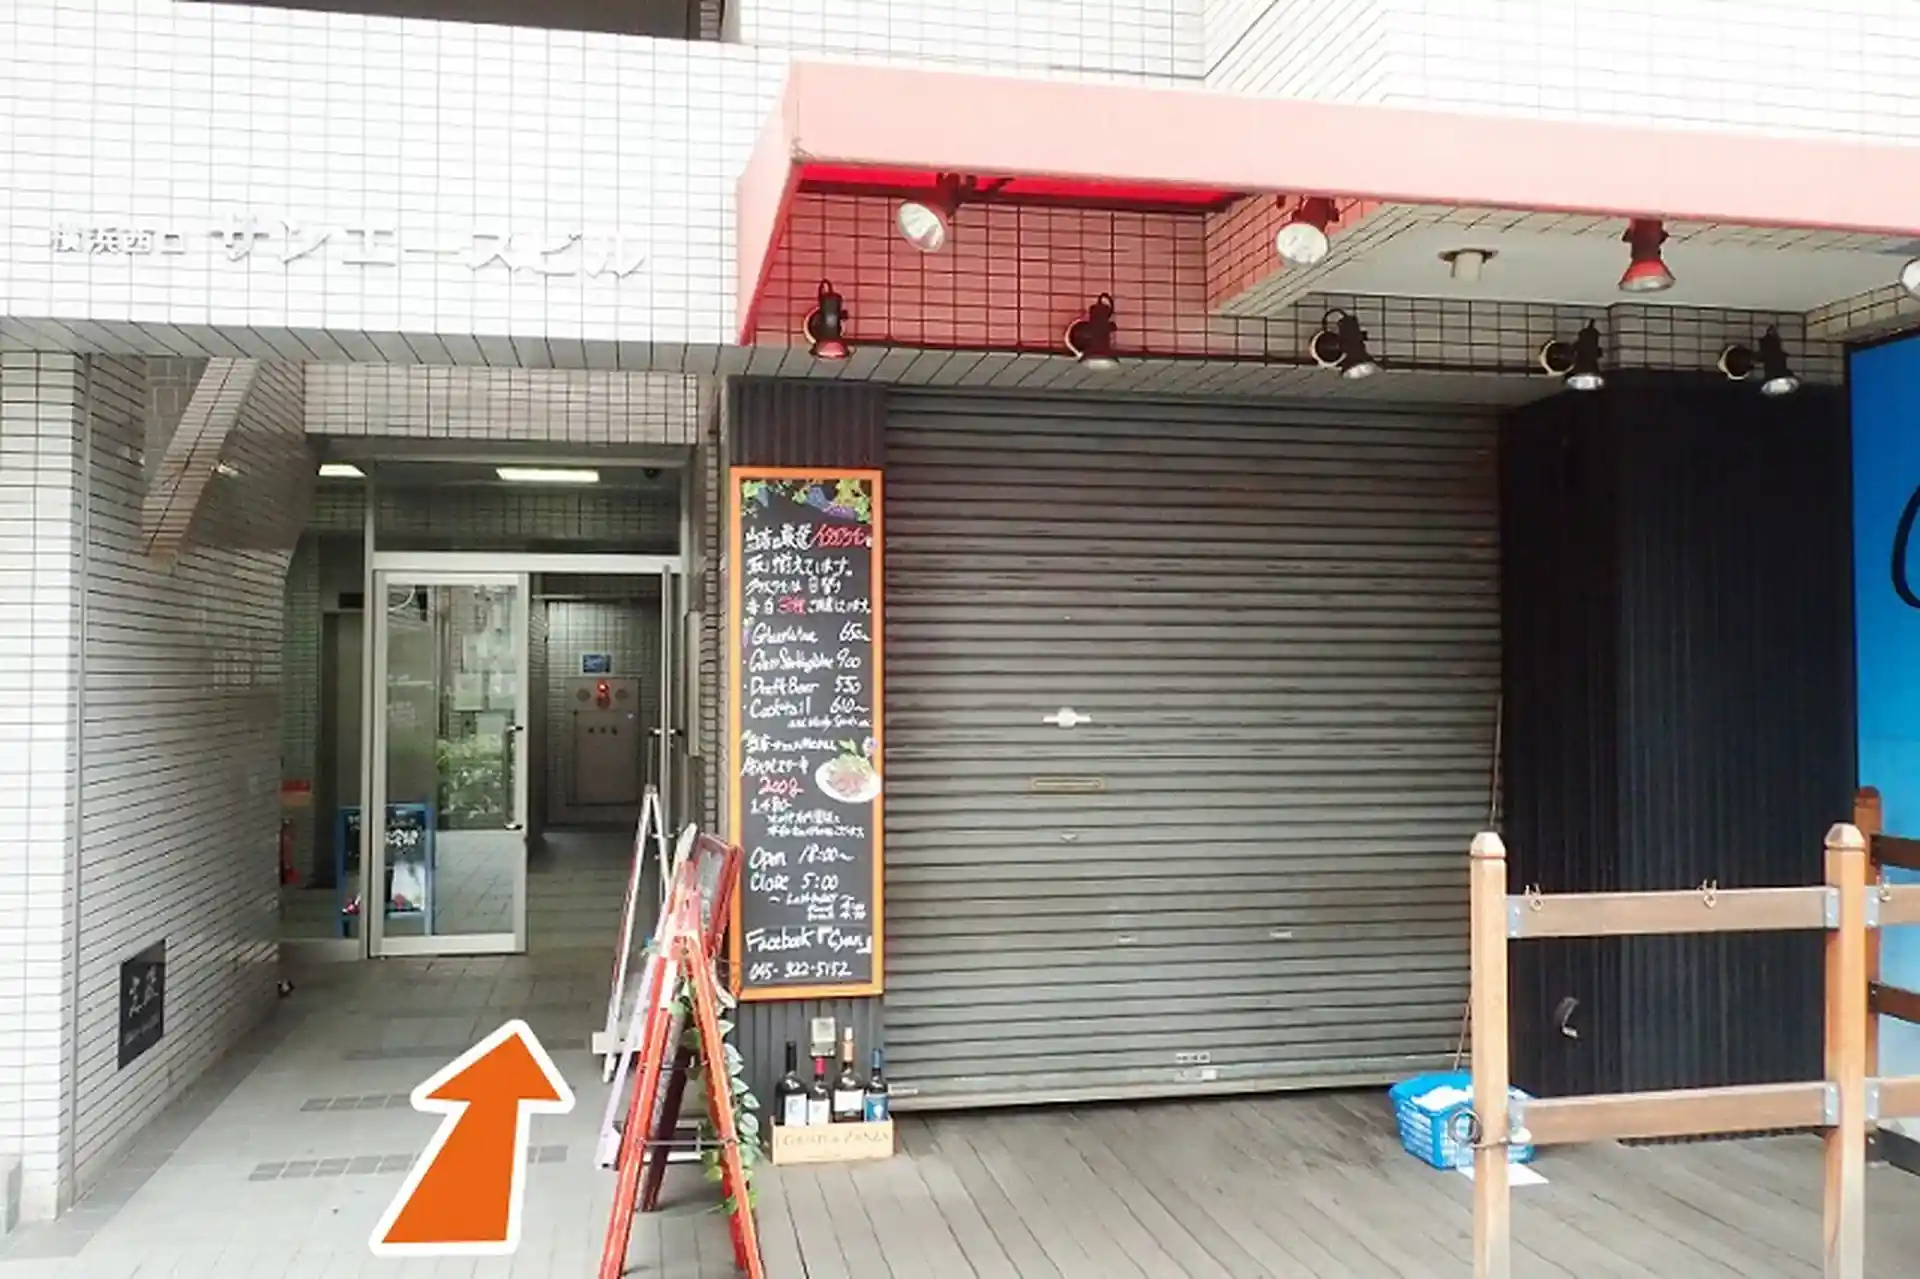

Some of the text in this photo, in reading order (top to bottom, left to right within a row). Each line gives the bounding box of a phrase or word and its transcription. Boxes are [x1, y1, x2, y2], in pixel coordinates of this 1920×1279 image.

[209, 213, 646, 280] サンエースビル
[836, 647, 862, 670] 900
[749, 846, 787, 871] Open
[750, 872, 790, 892] Close
